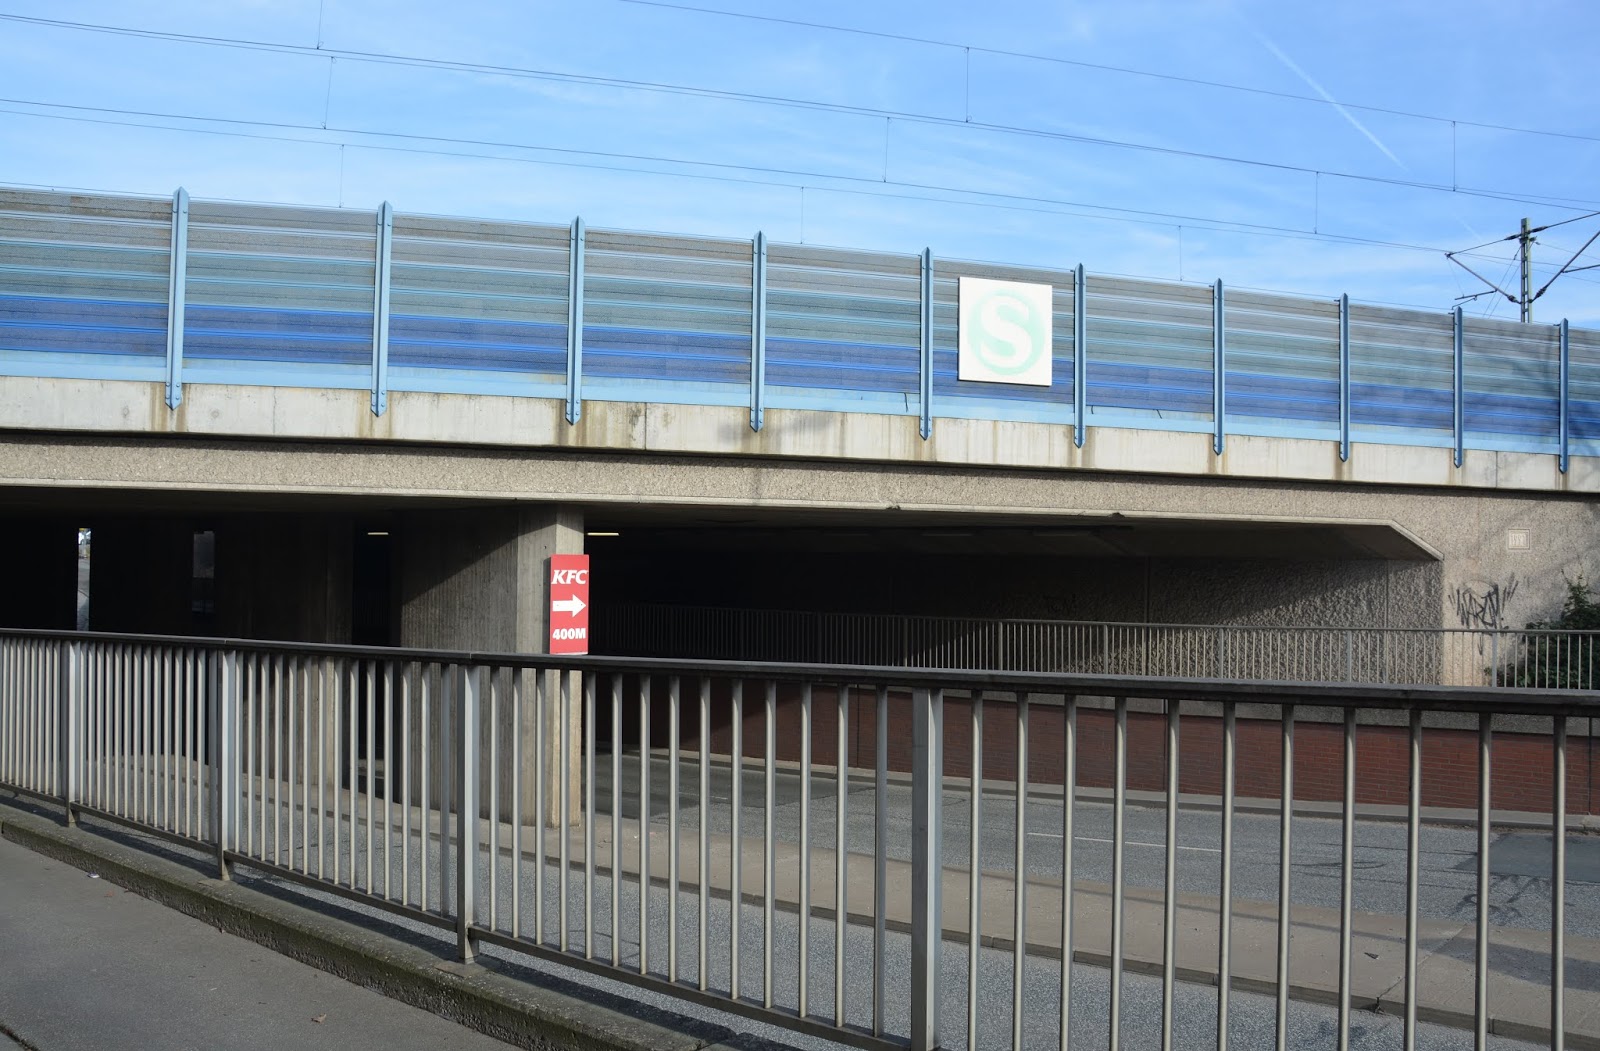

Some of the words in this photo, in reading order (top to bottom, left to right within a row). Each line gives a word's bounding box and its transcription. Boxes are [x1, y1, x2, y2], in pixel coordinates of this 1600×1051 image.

[978, 293, 1034, 371] S
[551, 569, 588, 585] KFC
[552, 628, 587, 640] 400M
